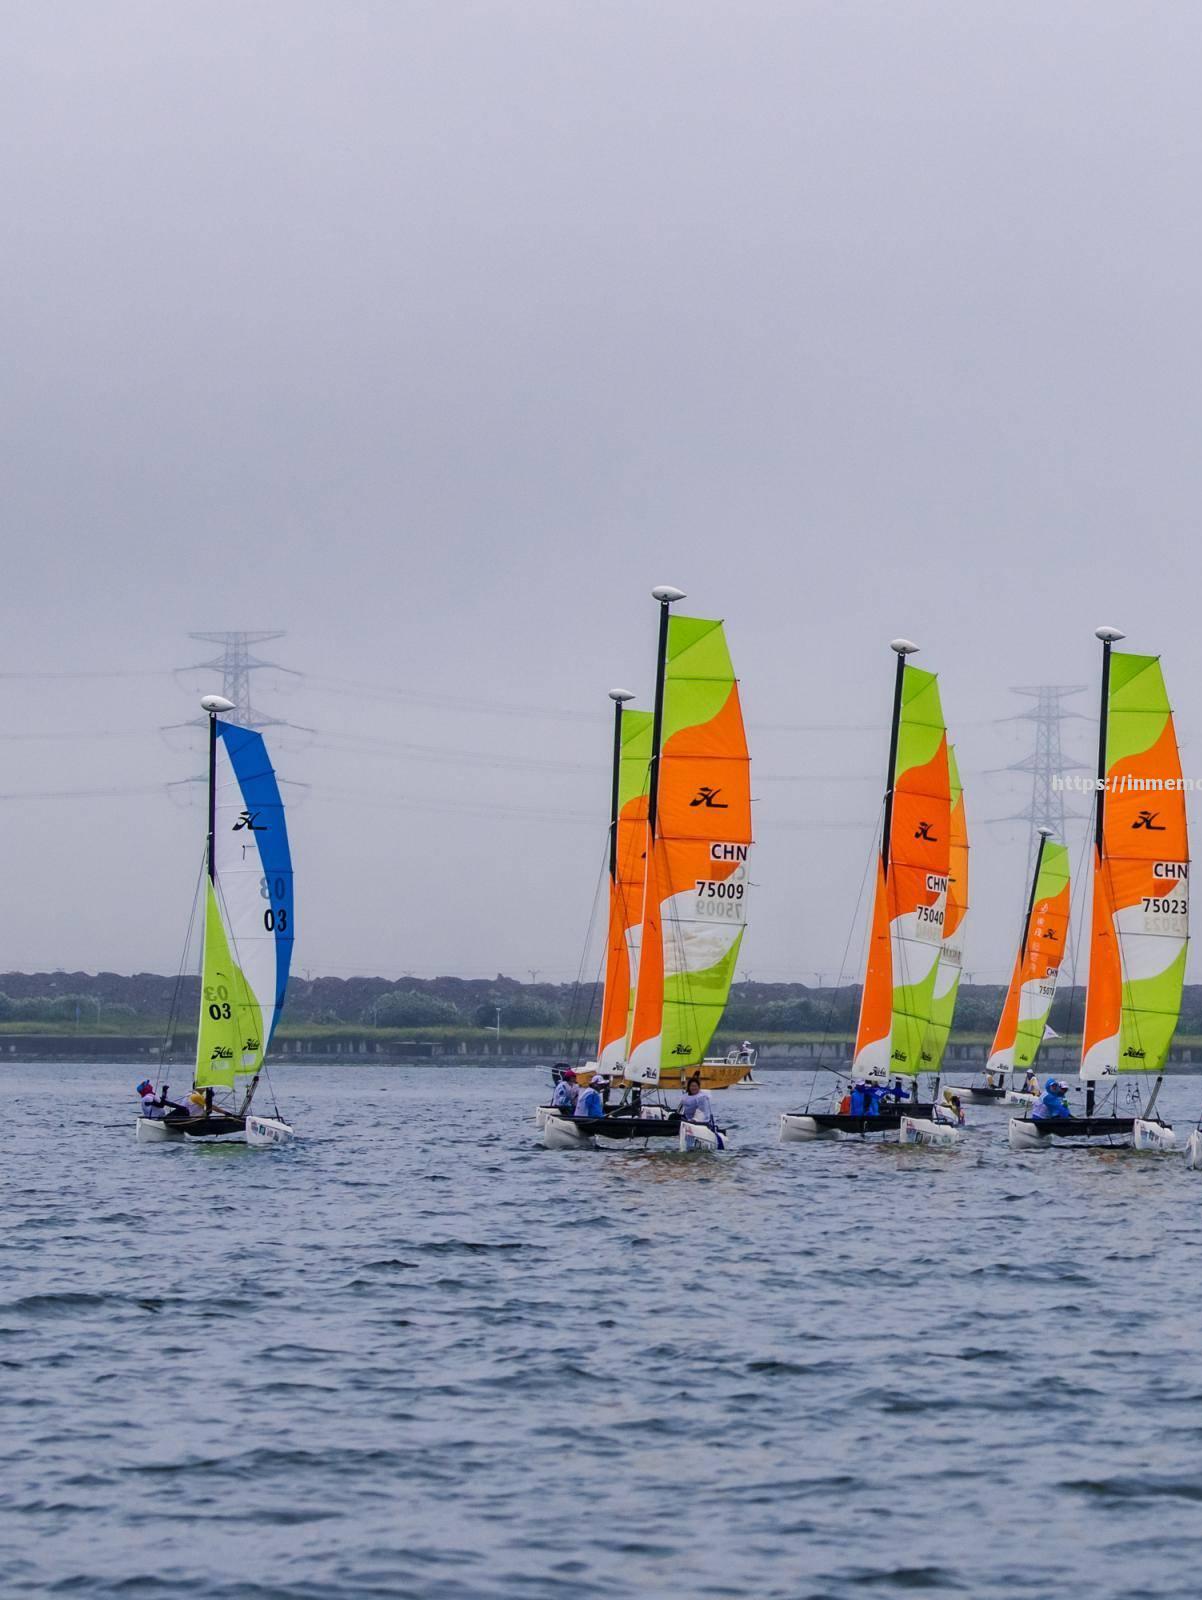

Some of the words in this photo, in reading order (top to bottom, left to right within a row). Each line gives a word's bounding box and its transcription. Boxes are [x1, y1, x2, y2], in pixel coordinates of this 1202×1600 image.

[711, 844, 747, 861] CHN
[1154, 863, 1188, 879] CHN
[696, 881, 744, 899] 75009
[927, 876, 947, 892] CHN
[1142, 898, 1187, 914] 75023
[264, 909, 287, 931] 03
[917, 906, 944, 925] 75040
[209, 1003, 231, 1020] 03
